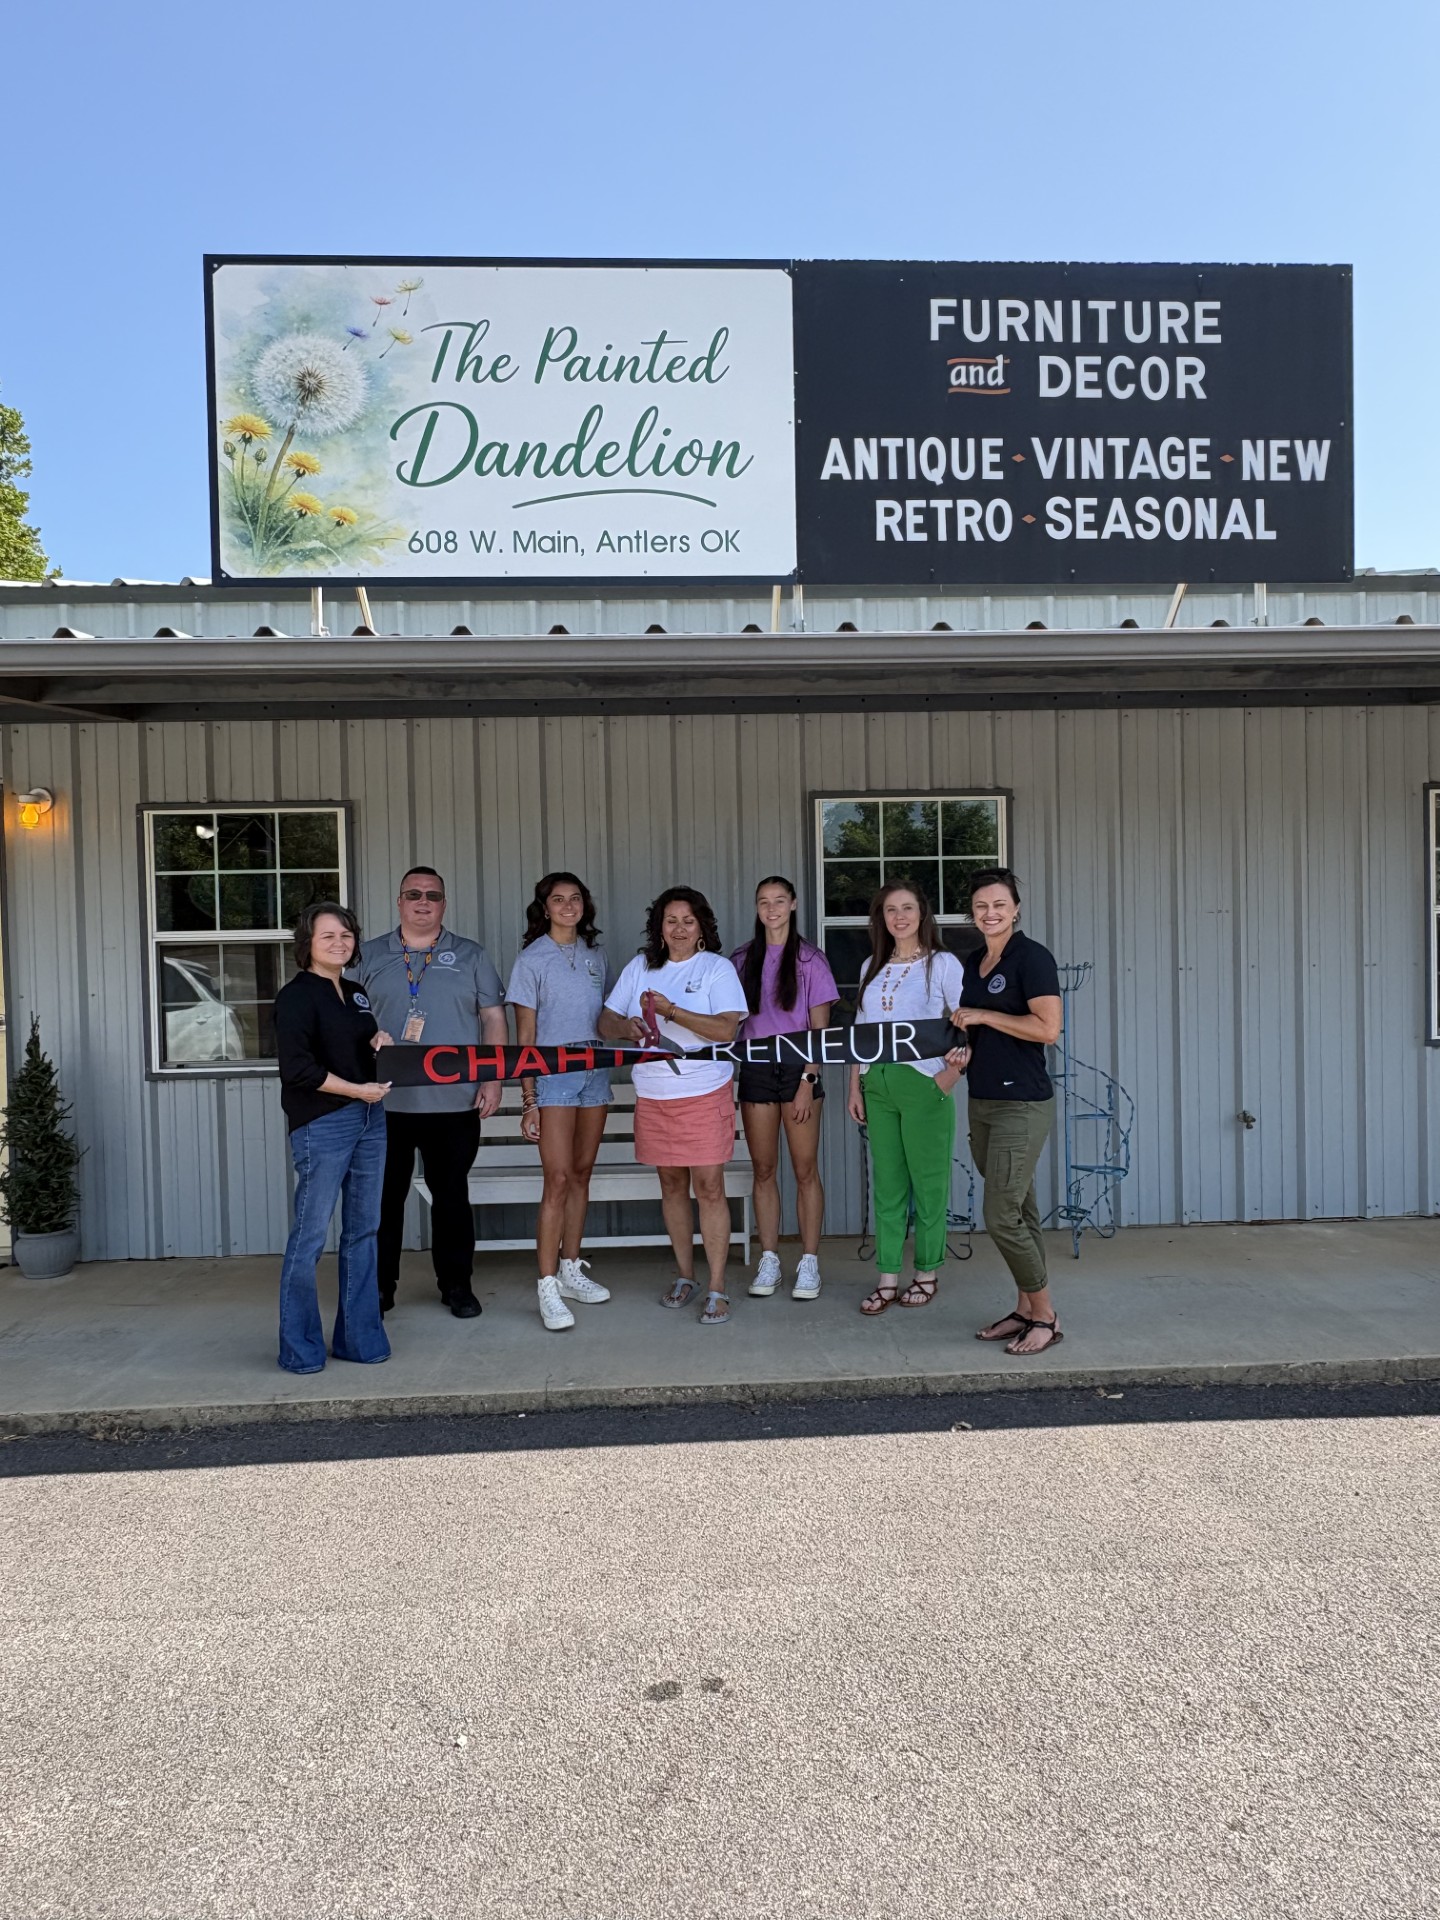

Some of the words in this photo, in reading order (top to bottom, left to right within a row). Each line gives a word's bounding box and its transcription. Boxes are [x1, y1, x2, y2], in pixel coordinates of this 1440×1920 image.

[930, 298, 1222, 344] FURNITURE
[420, 318, 520, 384] The
[534, 326, 730, 385] Painted
[949, 353, 1008, 387] and
[1038, 355, 1207, 401] DECOR
[389, 401, 755, 488] Dandelion
[820, 436, 1004, 486] ANTIQUE
[1030, 436, 1212, 480] VINTAGE
[1241, 439, 1331, 482] NEW
[875, 497, 1013, 542] RETRO
[1044, 495, 1277, 541] SEASONAL
[407, 529, 458, 554] 608
[469, 529, 504, 554] W.
[513, 529, 586, 558] Main,
[595, 529, 691, 554] Antlers
[700, 529, 741, 554] OK
